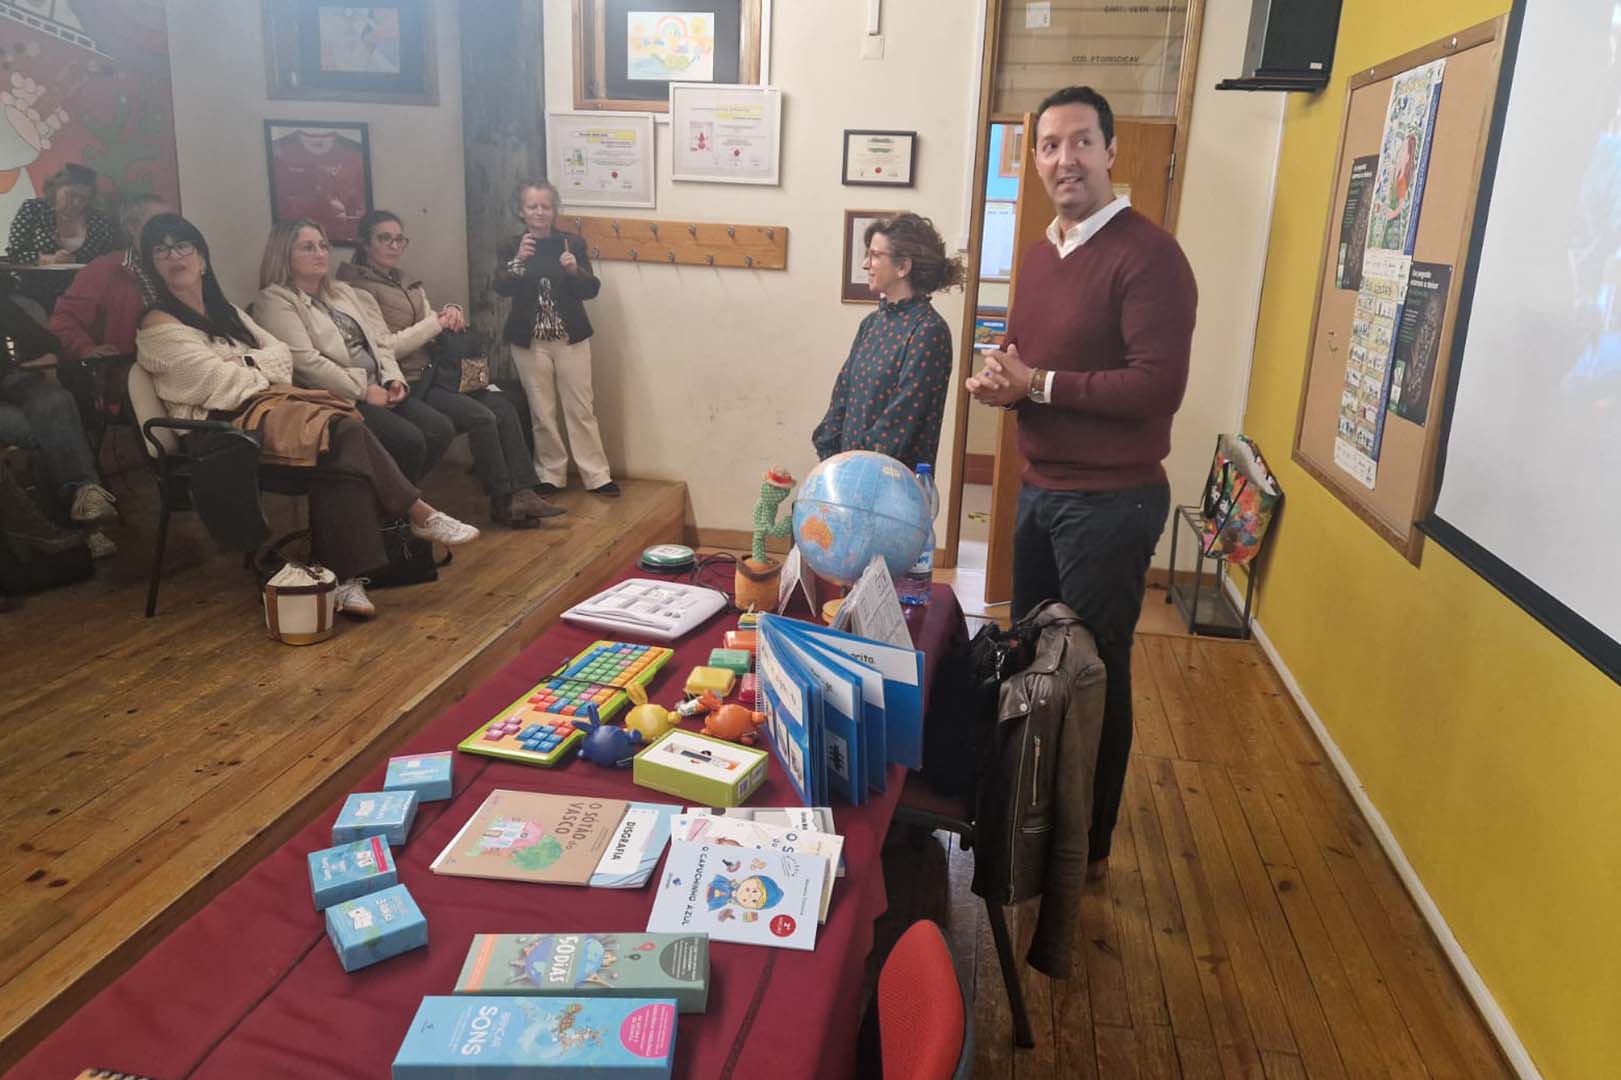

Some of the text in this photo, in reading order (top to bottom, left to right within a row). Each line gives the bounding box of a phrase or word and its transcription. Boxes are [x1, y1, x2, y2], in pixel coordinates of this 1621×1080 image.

[554, 802, 585, 835] VASCO
[588, 802, 602, 810] O
[572, 811, 601, 840] SÓTÃO
[611, 821, 636, 860] DISGRAFIA
[688, 853, 708, 902] CAPUCHINHO
[681, 904, 694, 927] AZUL
[555, 936, 579, 954] 50
[461, 1005, 499, 1056] SONS
